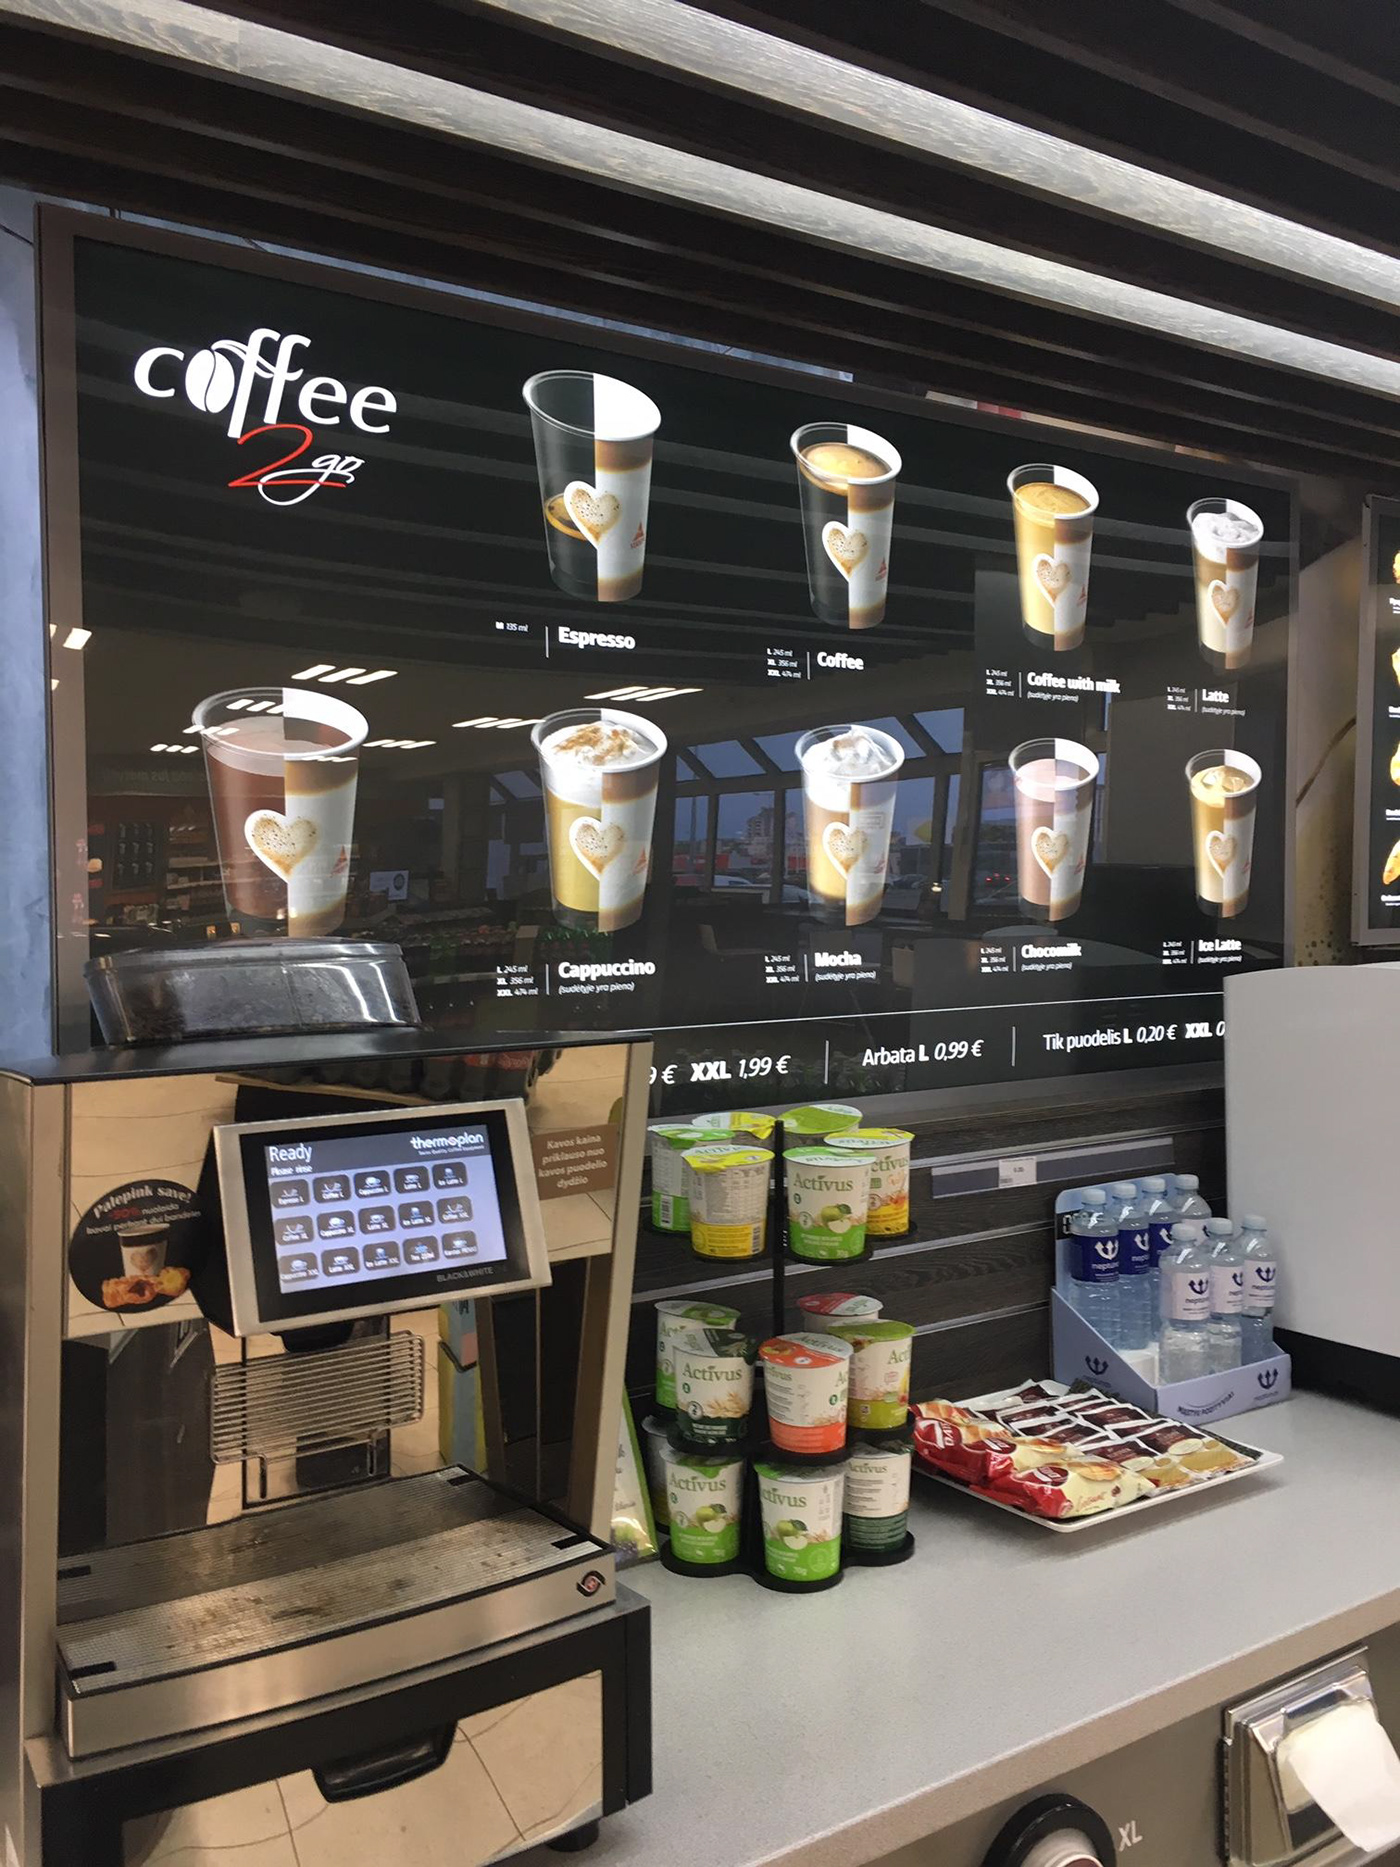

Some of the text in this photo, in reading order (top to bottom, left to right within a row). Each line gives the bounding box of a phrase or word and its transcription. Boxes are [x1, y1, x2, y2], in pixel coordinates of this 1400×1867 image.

[134, 327, 398, 439] coffee
[558, 626, 636, 650] Espresso
[817, 651, 864, 670] Coffee
[1027, 672, 1120, 693] Coffee with milk
[1202, 689, 1229, 703] Latte
[1198, 938, 1242, 952] Ice Latte
[814, 950, 862, 967] Mocha
[558, 959, 656, 981] Cappuccino
[1043, 1033, 1065, 1051] Tik
[1066, 1029, 1121, 1053] puodelis
[1123, 1027, 1133, 1044] L
[1136, 1025, 1164, 1044] 0,20
[1166, 1024, 1178, 1041] €
[1185, 1022, 1212, 1039] XXL
[862, 1039, 985, 1067] Arbata L 0,99 €
[661, 1064, 678, 1085] €
[690, 1061, 731, 1082] XXL
[737, 1057, 772, 1080] 1,99
[775, 1055, 792, 1075] €
[410, 1131, 484, 1150] thermoplan
[547, 1135, 601, 1149] Kavos kaina
[269, 1143, 312, 1162] Ready
[542, 1148, 605, 1166] priklauso nuo
[538, 1160, 608, 1177] kavos puodelio
[871, 1155, 908, 1173] ctivus
[793, 1172, 854, 1192] Activus
[682, 1362, 743, 1382] Activus
[668, 1472, 727, 1493] Activus
[762, 1488, 808, 1508] ctivus
[1119, 1820, 1144, 1852] XL
